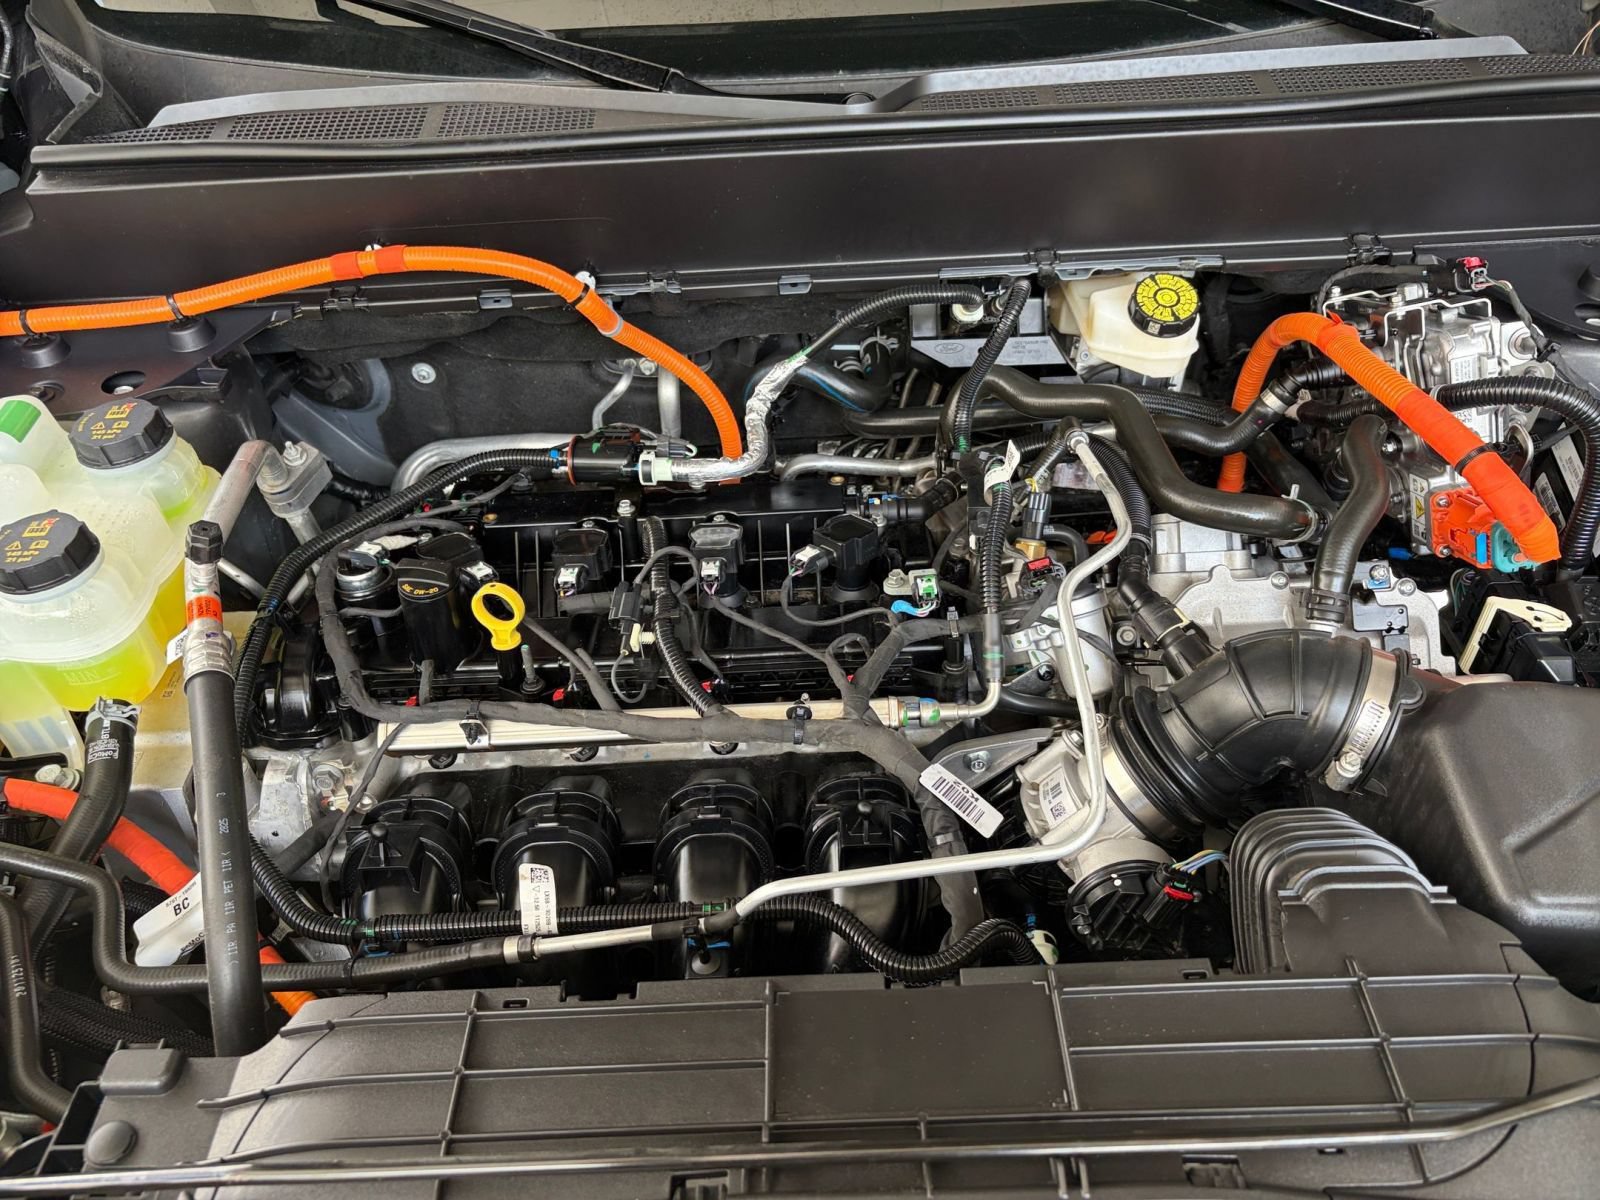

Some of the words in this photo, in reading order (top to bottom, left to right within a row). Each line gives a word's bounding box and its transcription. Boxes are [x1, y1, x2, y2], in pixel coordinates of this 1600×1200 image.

[952, 778, 980, 802] K02
[223, 880, 234, 894] PET
[173, 897, 190, 916] BC
